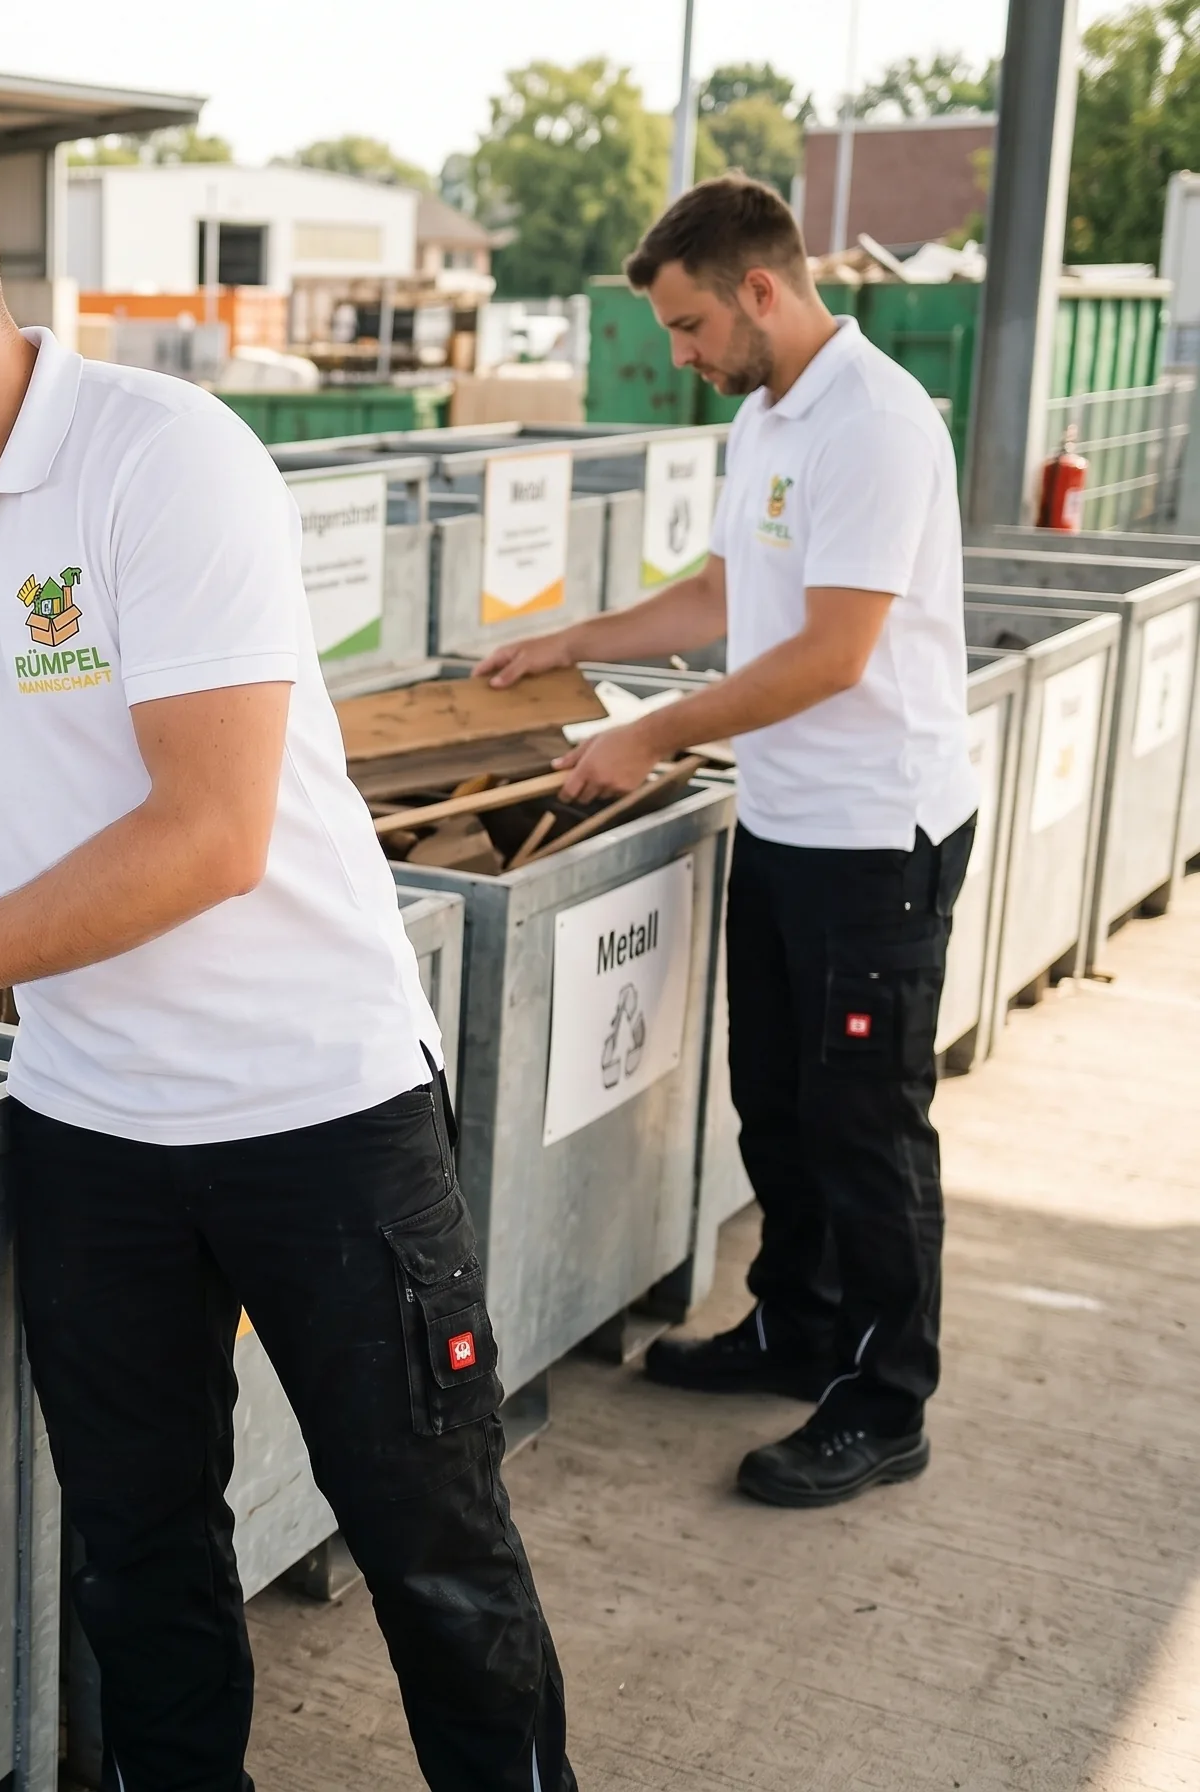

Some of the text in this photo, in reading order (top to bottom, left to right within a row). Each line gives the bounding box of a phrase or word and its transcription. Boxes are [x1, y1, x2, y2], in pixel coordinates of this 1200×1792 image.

[15, 646, 110, 678] RÜMPEL
[18, 670, 112, 694] MANNSCHAFT
[597, 909, 659, 975] Metall
